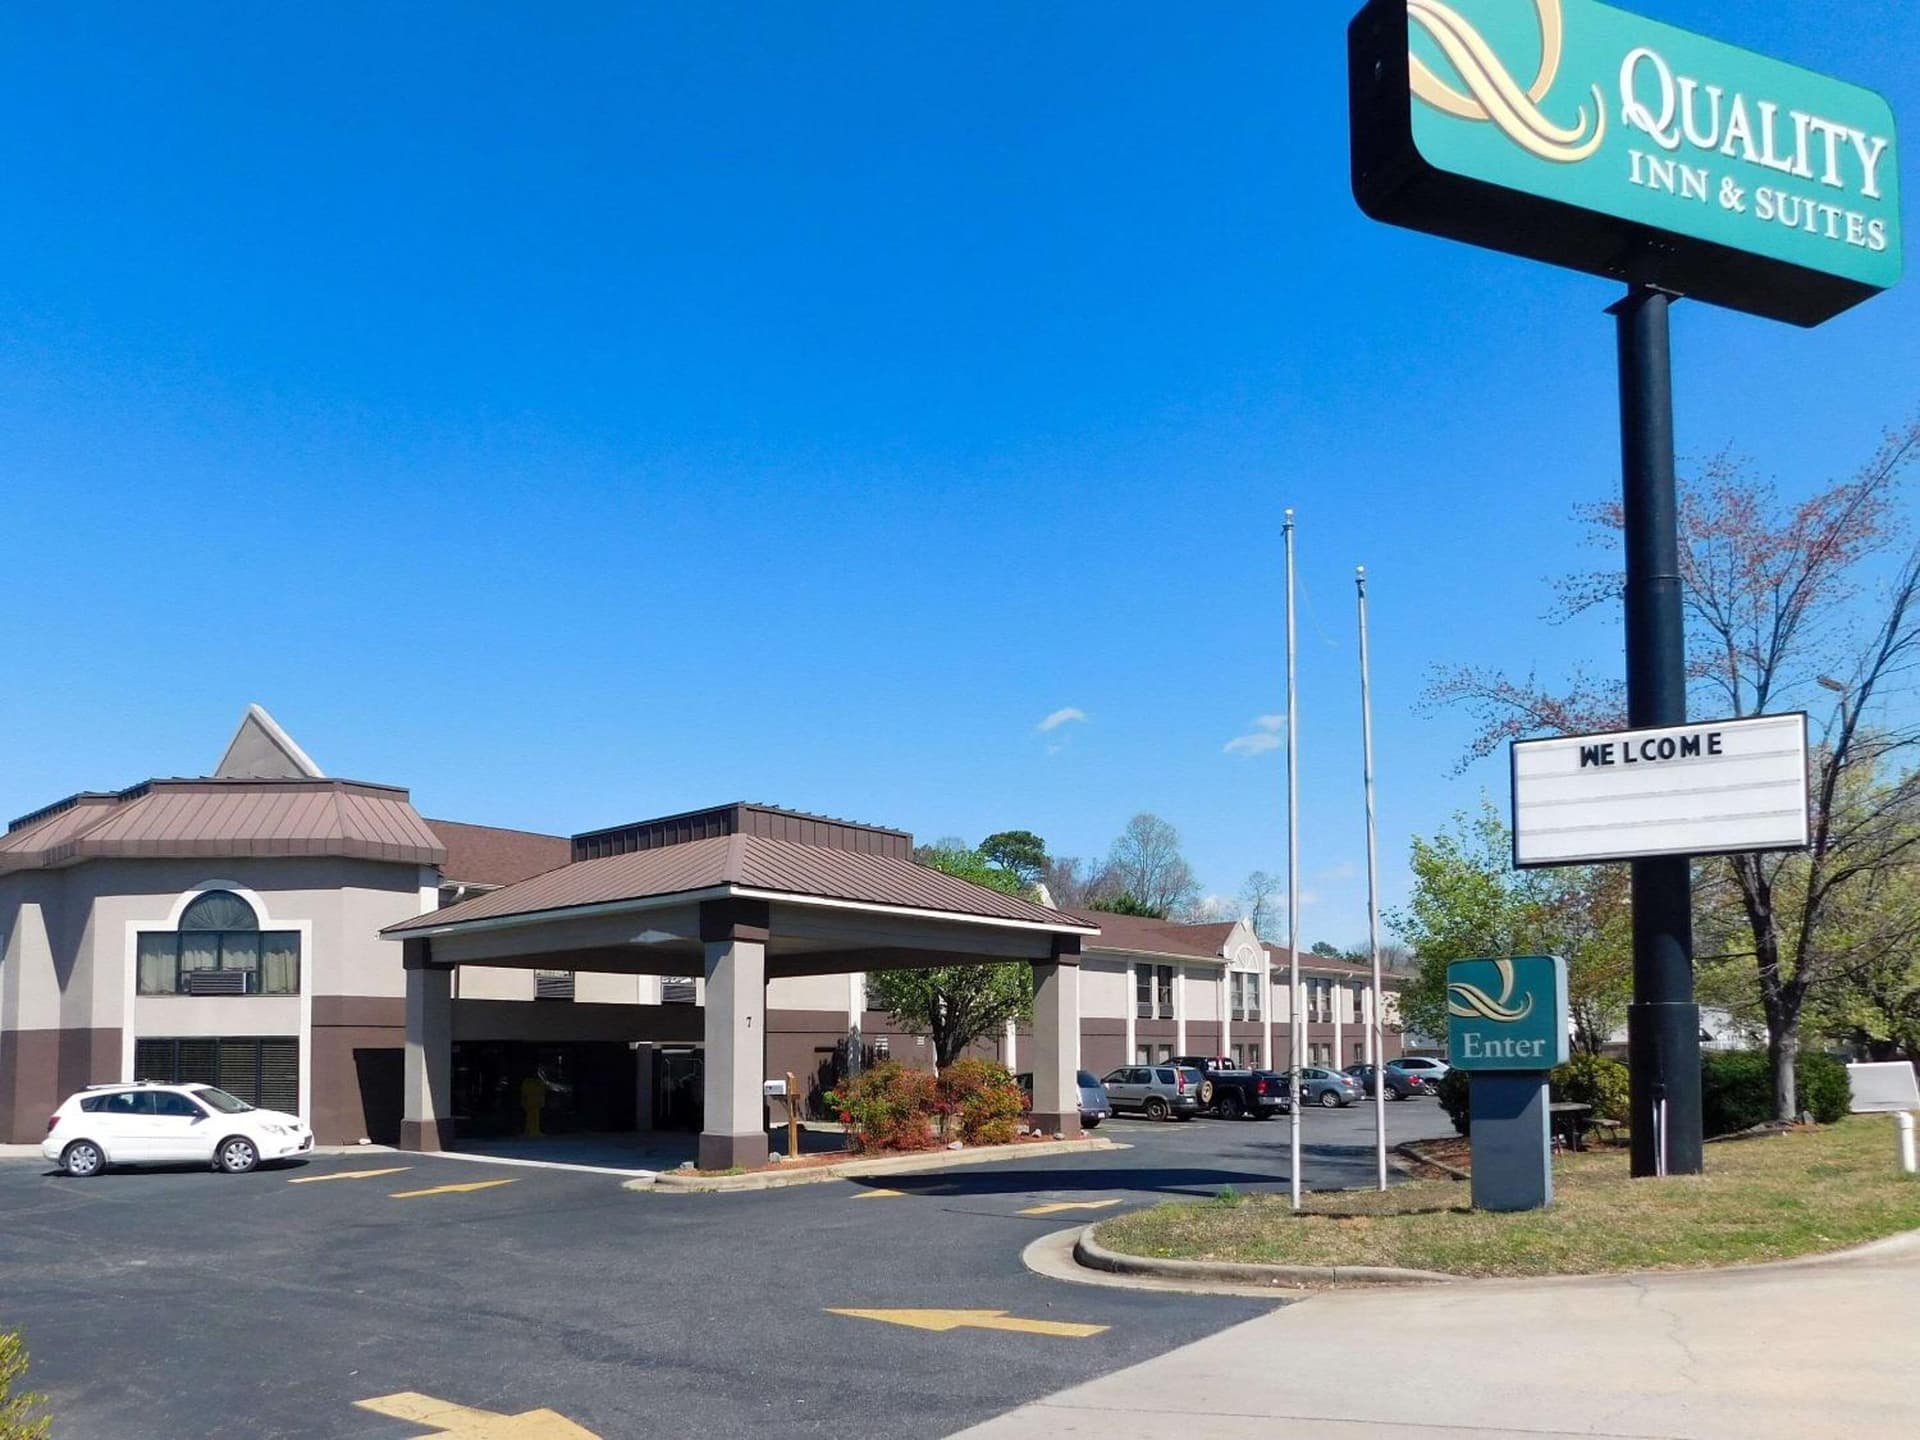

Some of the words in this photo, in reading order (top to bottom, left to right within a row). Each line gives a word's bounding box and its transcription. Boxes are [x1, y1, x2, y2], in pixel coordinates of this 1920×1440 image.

[1618, 47, 1888, 199] QUALITY
[1628, 149, 1710, 204] INN
[1718, 176, 1746, 213] &
[1755, 186, 1887, 252] SUITES
[1580, 732, 1722, 768] WELCOME
[1462, 1032, 1546, 1058] Enter
